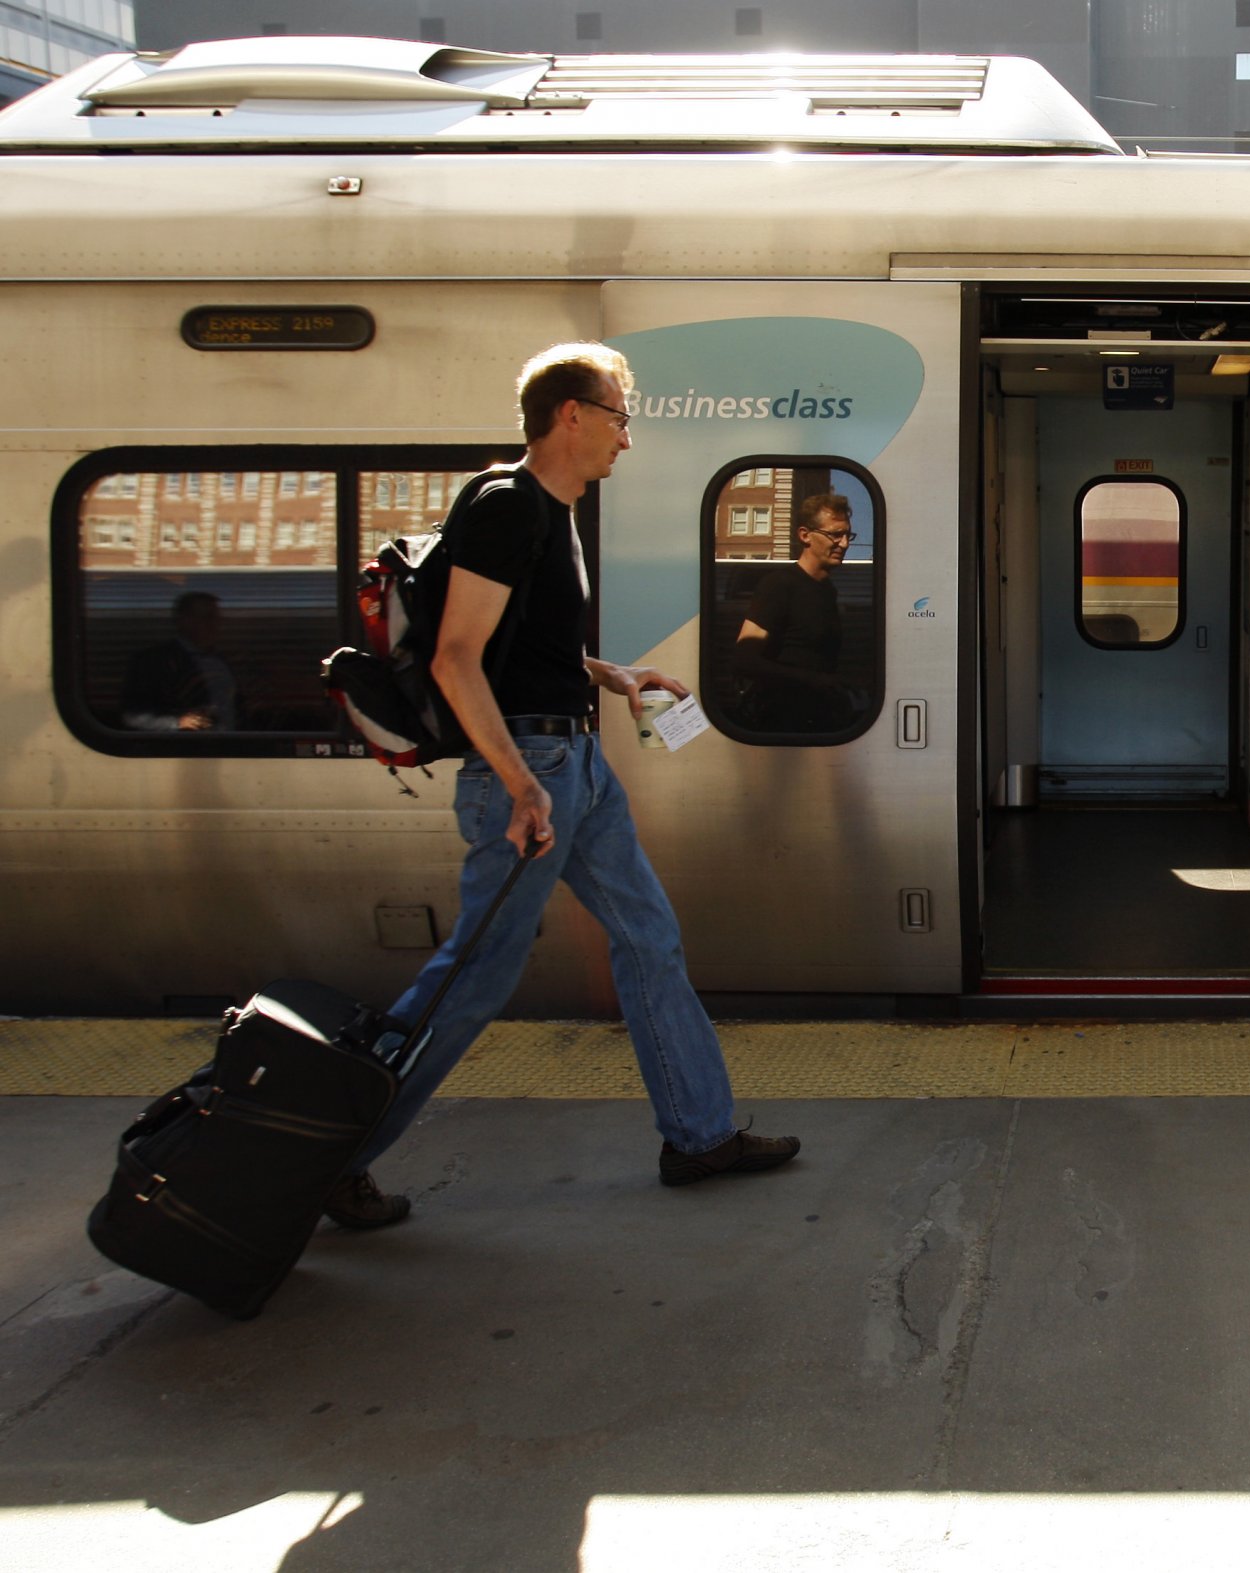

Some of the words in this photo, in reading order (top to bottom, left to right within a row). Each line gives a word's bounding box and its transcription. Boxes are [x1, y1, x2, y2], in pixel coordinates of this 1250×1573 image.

[209, 317, 282, 331] EXPRESS
[292, 317, 334, 330] 2159
[1131, 367, 1153, 375] Quiet
[1154, 367, 1168, 375] Car
[1129, 461, 1150, 469] EXIT
[908, 610, 935, 618] acela
